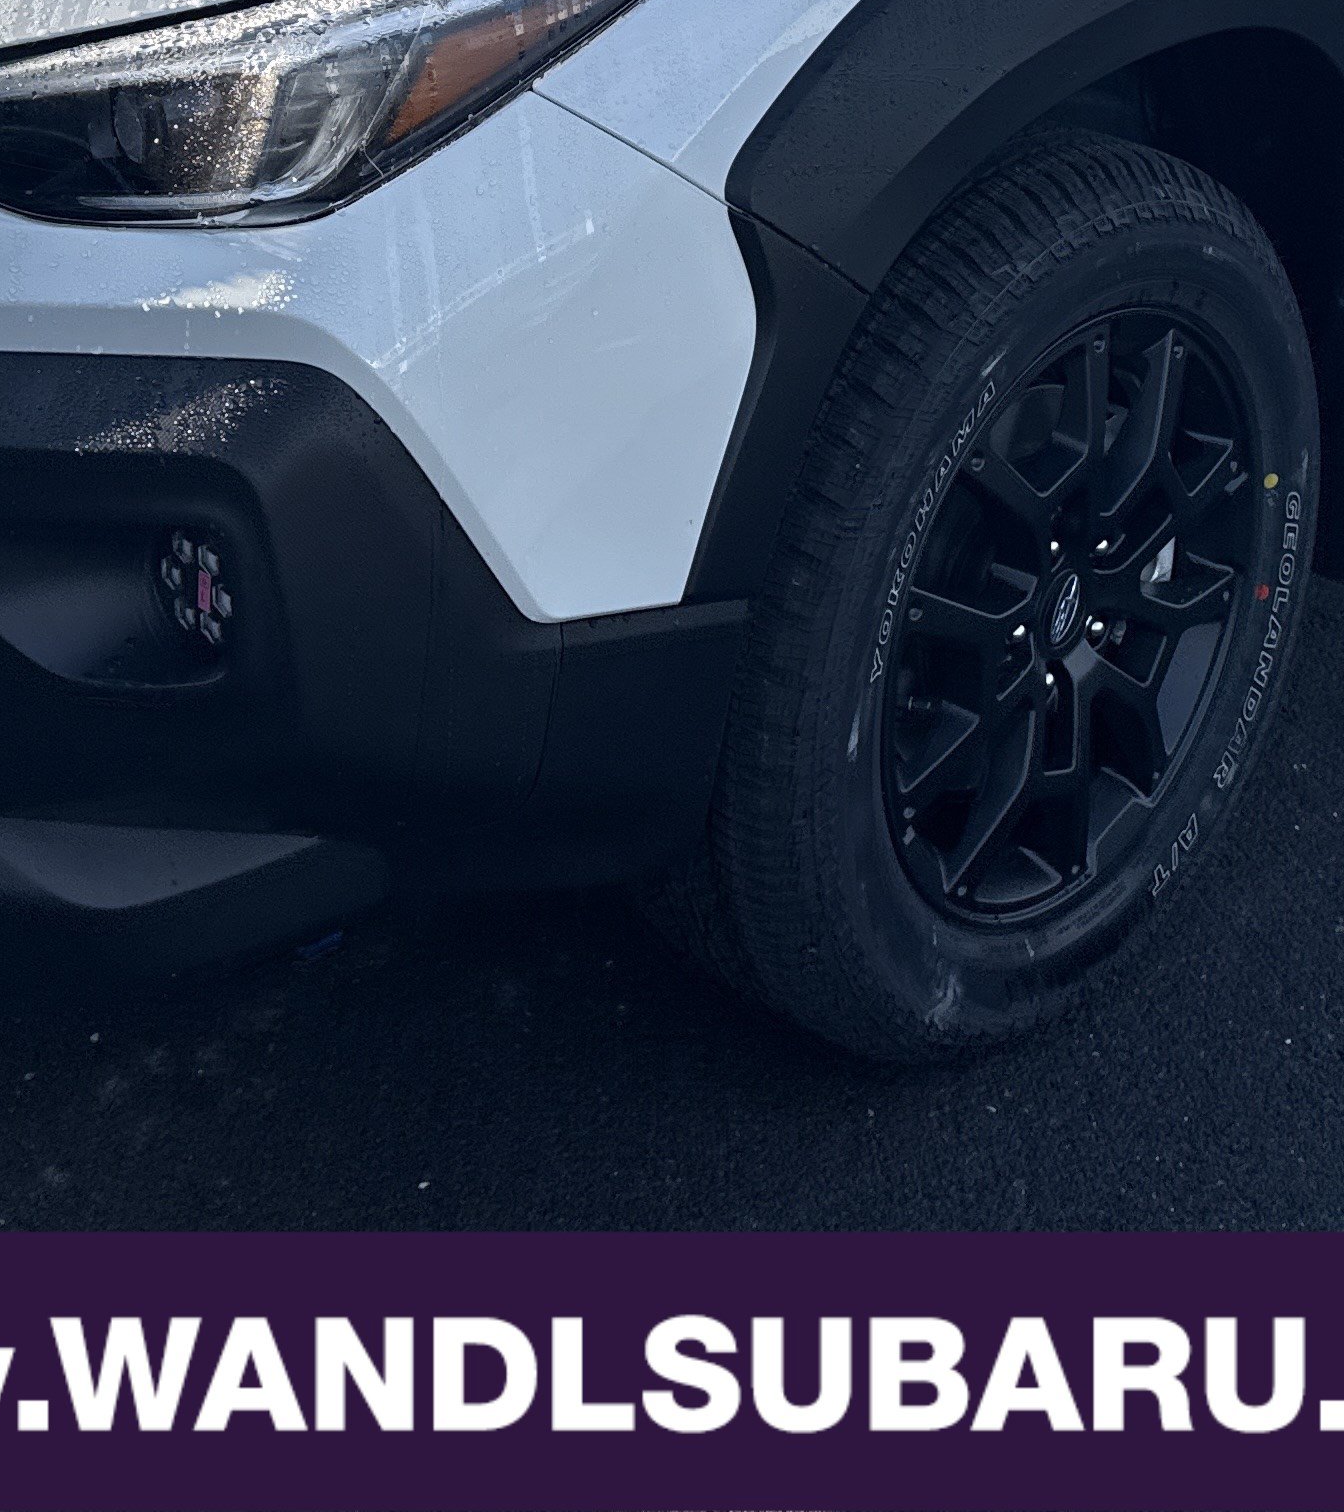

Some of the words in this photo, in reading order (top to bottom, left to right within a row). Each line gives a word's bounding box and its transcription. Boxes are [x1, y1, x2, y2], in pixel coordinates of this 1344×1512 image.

[869, 381, 996, 684] YOKOHAMA
[1211, 490, 1301, 789] GEOLANDAR
[1151, 813, 1199, 897] A/T
